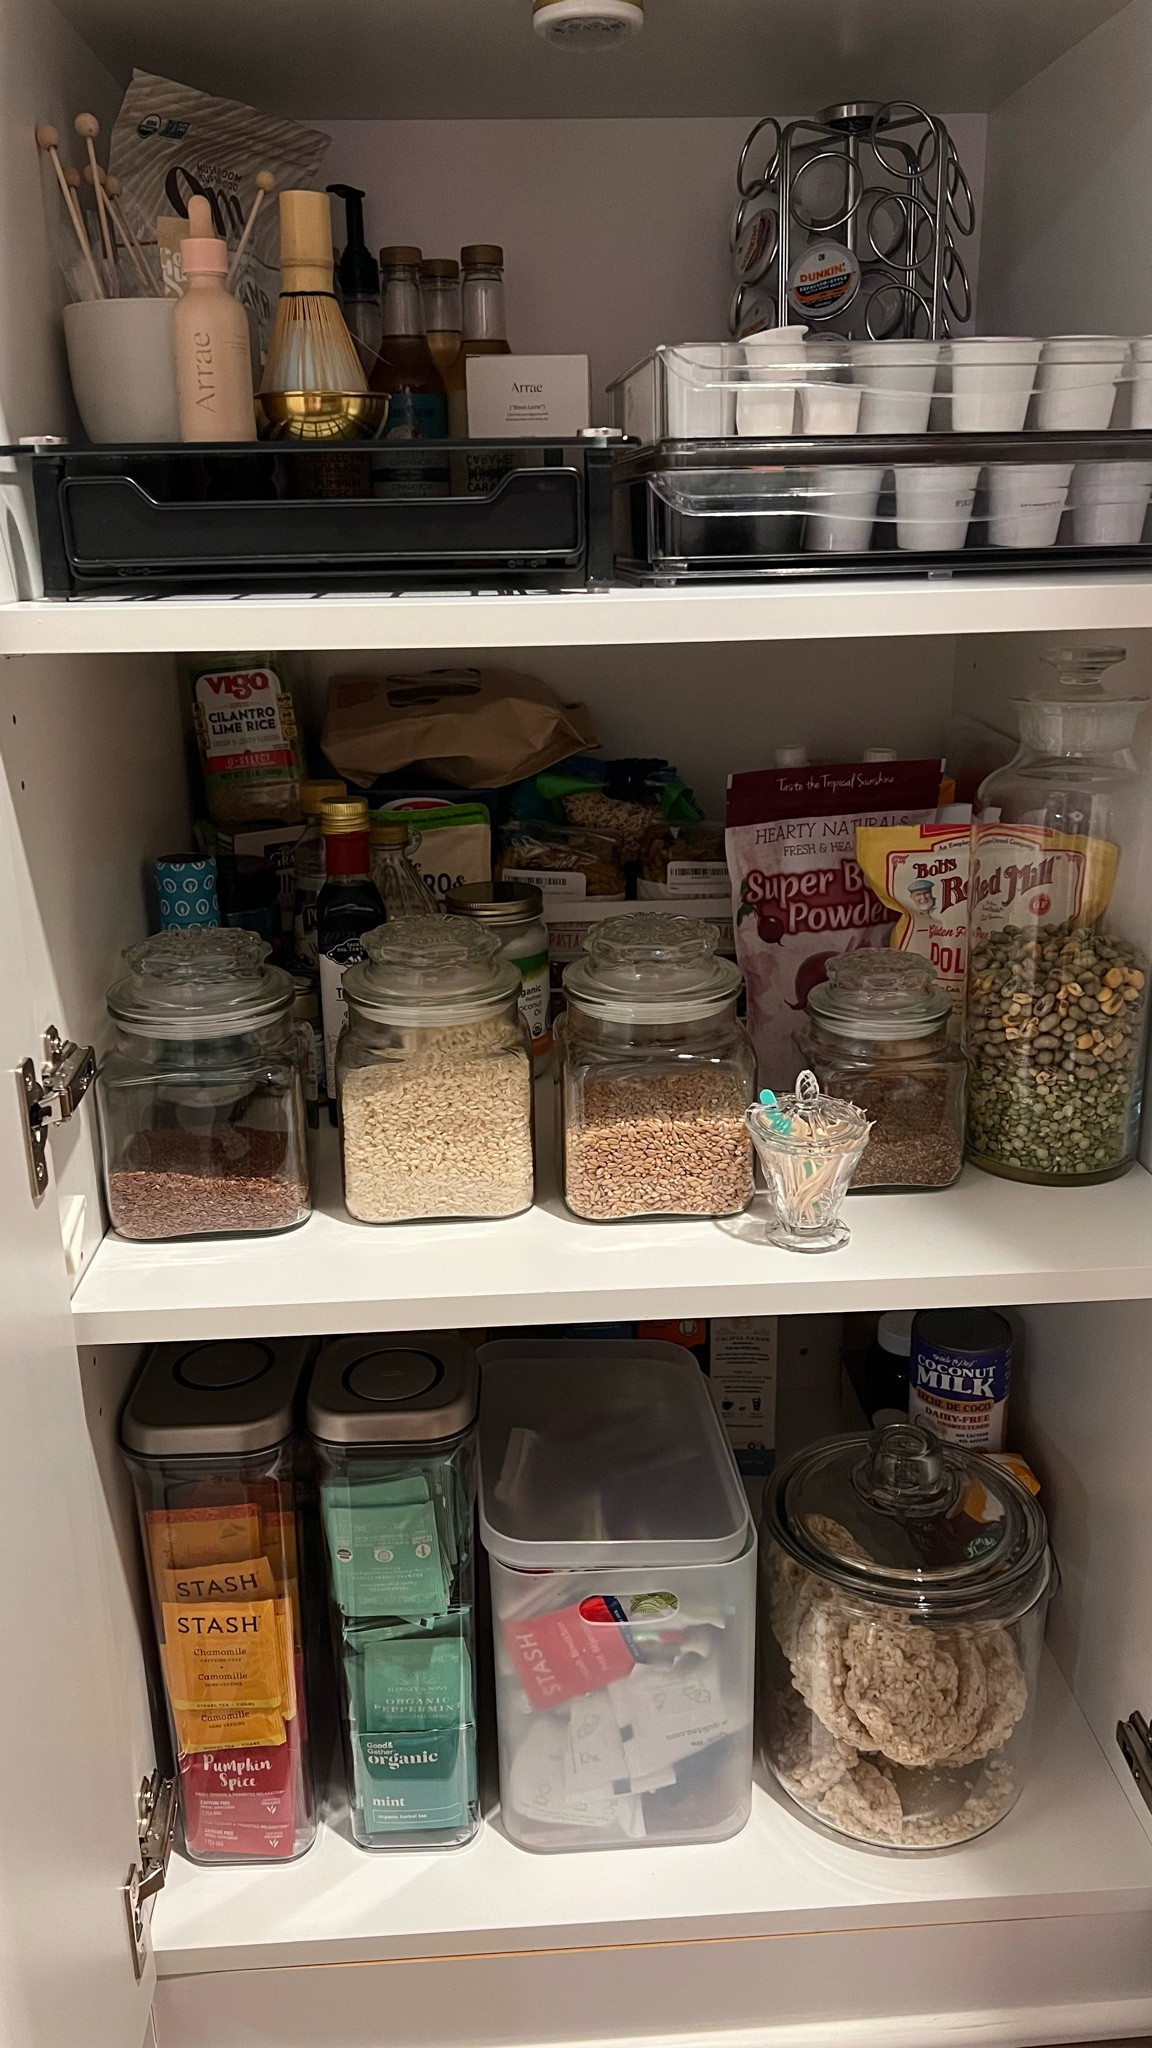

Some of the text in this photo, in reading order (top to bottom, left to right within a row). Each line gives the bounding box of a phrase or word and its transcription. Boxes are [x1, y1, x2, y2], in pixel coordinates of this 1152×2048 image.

[195, 332, 216, 413] Arrae
[511, 381, 543, 393] Arrae
[467, 481, 496, 492] CARA
[208, 706, 275, 724] CILANTRO
[212, 719, 276, 735] LIME RICE
[776, 771, 895, 794] Taste the Tropical Sunshine
[755, 822, 817, 845] HEARTY
[783, 841, 854, 857] FRESH & HEA
[1002, 855, 1056, 906] Mill
[745, 869, 835, 910] Super
[788, 890, 889, 934] Powder
[929, 925, 953, 939] Gluten
[521, 985, 542, 998] ganic
[519, 1000, 542, 1011] oconut
[917, 1354, 996, 1378] COCONUT
[916, 1364, 995, 1398] MILK
[925, 1406, 990, 1423] DAIRY-FREE
[946, 1401, 961, 1412] DE
[963, 1403, 991, 1412] COCO
[177, 1573, 259, 1597] STASH
[177, 1616, 259, 1634] STASH
[193, 1648, 247, 1657] Chamomile
[515, 1633, 562, 1697] STASH
[197, 1672, 248, 1681] Camomille
[373, 1702, 460, 1713] PEPPERMINT
[385, 1697, 451, 1705] ORGANIC
[201, 1710, 250, 1722] Camomille
[203, 1754, 272, 1775] Pumpkin
[368, 1751, 438, 1770] organic
[219, 1773, 256, 1791] Spice
[372, 1796, 405, 1807] mint
